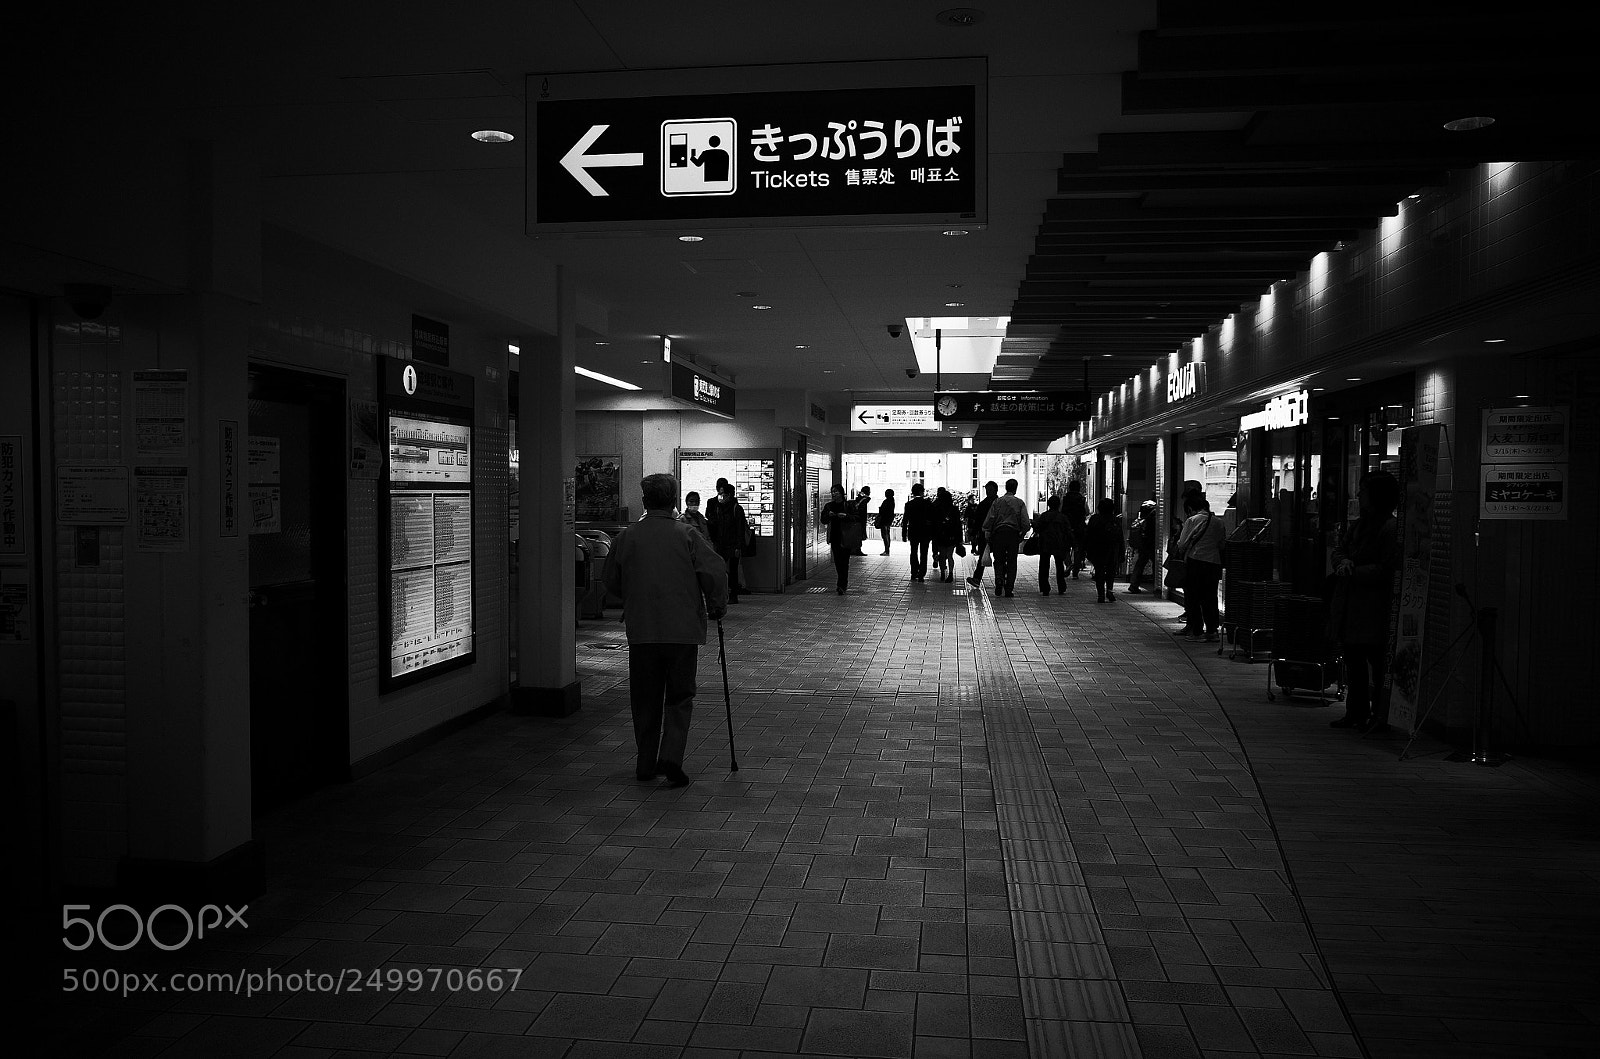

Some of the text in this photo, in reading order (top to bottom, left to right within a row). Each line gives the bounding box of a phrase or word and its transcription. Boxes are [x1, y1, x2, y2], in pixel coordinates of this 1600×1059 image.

[750, 116, 963, 163] きっぷうりば
[751, 169, 830, 189] Tickets
[845, 168, 895, 187] 售票处
[910, 167, 960, 184] 매표소
[1499, 414, 1553, 424] 期間限定出店
[224, 426, 234, 532] 防犯カメラ作動中
[1498, 472, 1550, 480] 期間限定出店
[1, 442, 16, 549] 防犯カメラ作動中
[1490, 489, 1559, 501] ミヤコケーキ
